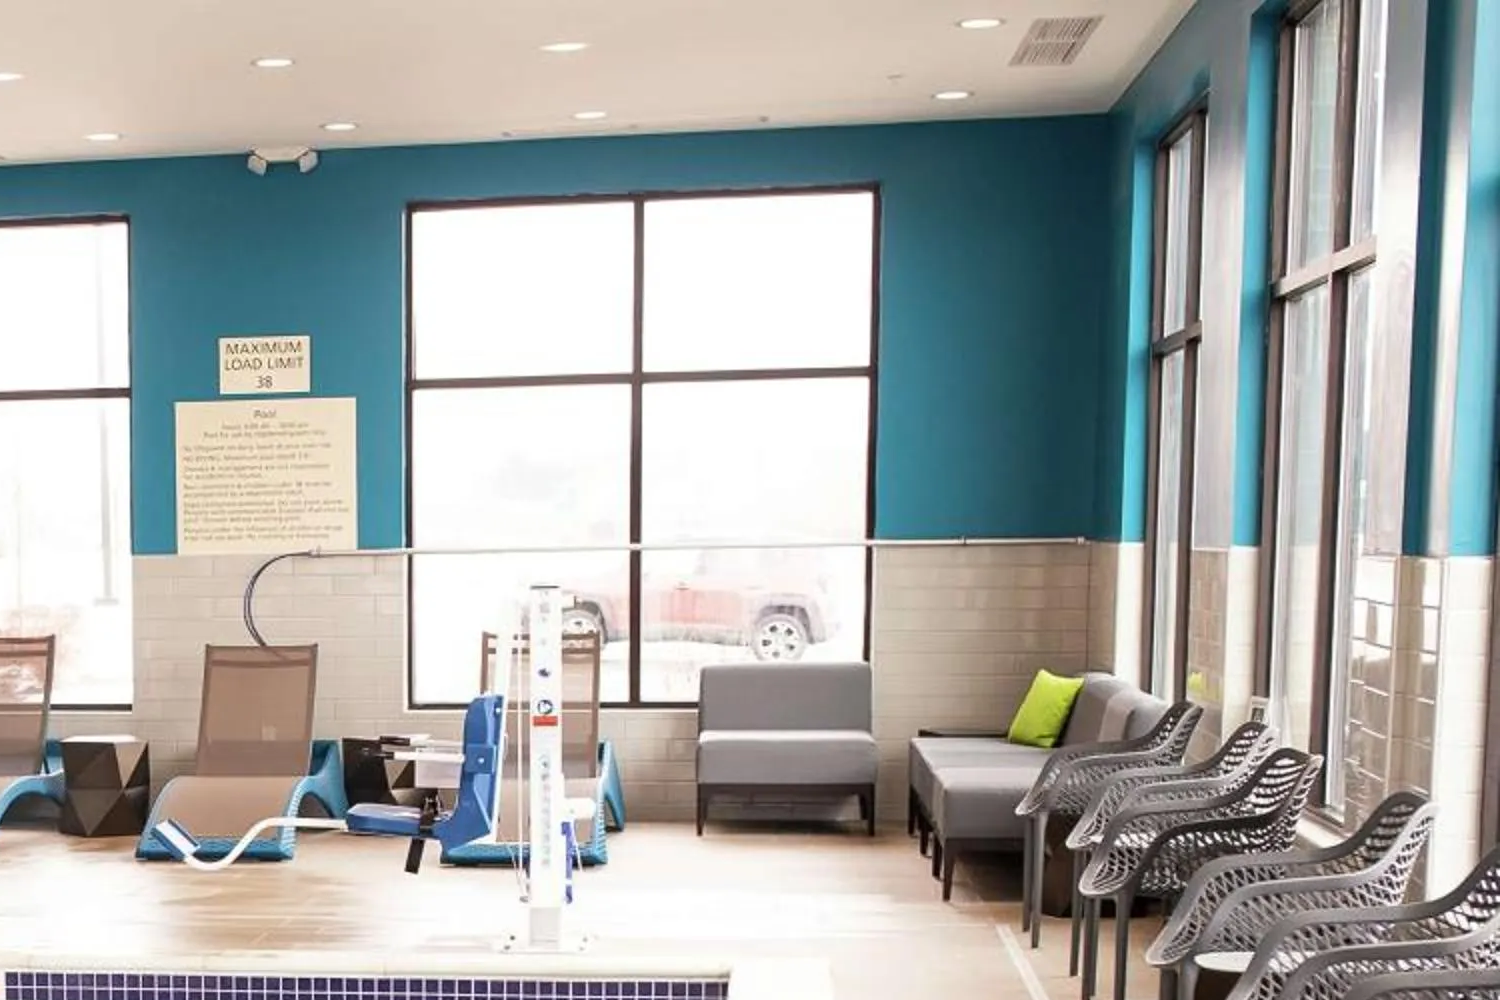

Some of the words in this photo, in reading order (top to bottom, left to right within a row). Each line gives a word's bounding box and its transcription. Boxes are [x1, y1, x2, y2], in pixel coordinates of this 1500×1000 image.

[225, 341, 303, 354] MAXIMUM
[224, 357, 263, 371] LOAD
[267, 356, 304, 369] LIMIT
[256, 375, 273, 389] 38
